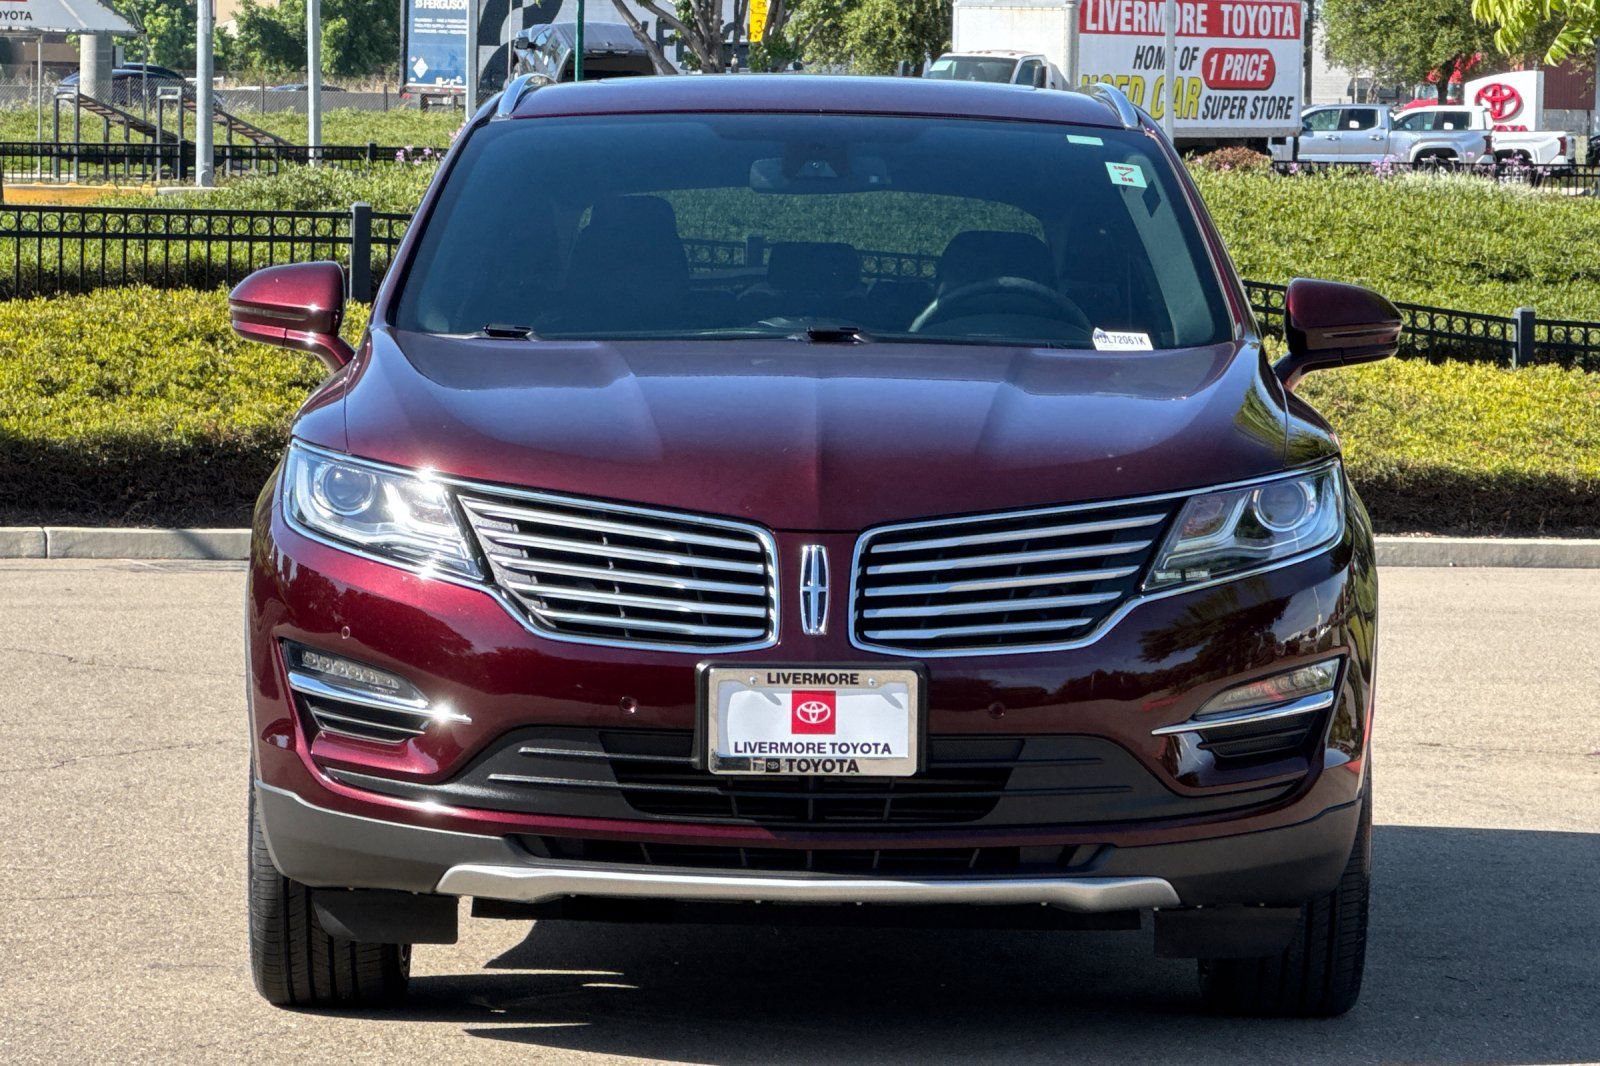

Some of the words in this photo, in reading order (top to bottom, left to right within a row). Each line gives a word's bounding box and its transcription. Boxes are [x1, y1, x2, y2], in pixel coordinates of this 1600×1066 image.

[1220, 4, 1295, 37] TOYOTA
[1133, 45, 1177, 70] HOM
[1179, 46, 1200, 70] OF
[1208, 55, 1216, 81] 1
[1221, 53, 1270, 82] PRICE
[1150, 74, 1202, 120] CAR
[1201, 95, 1247, 119] SUPER
[1250, 96, 1294, 120] STORE
[767, 672, 859, 685] LIVERMORE
[734, 741, 826, 754] LIVERMORE
[831, 742, 892, 754] TOYOTA
[785, 759, 860, 773] TOYOTA
